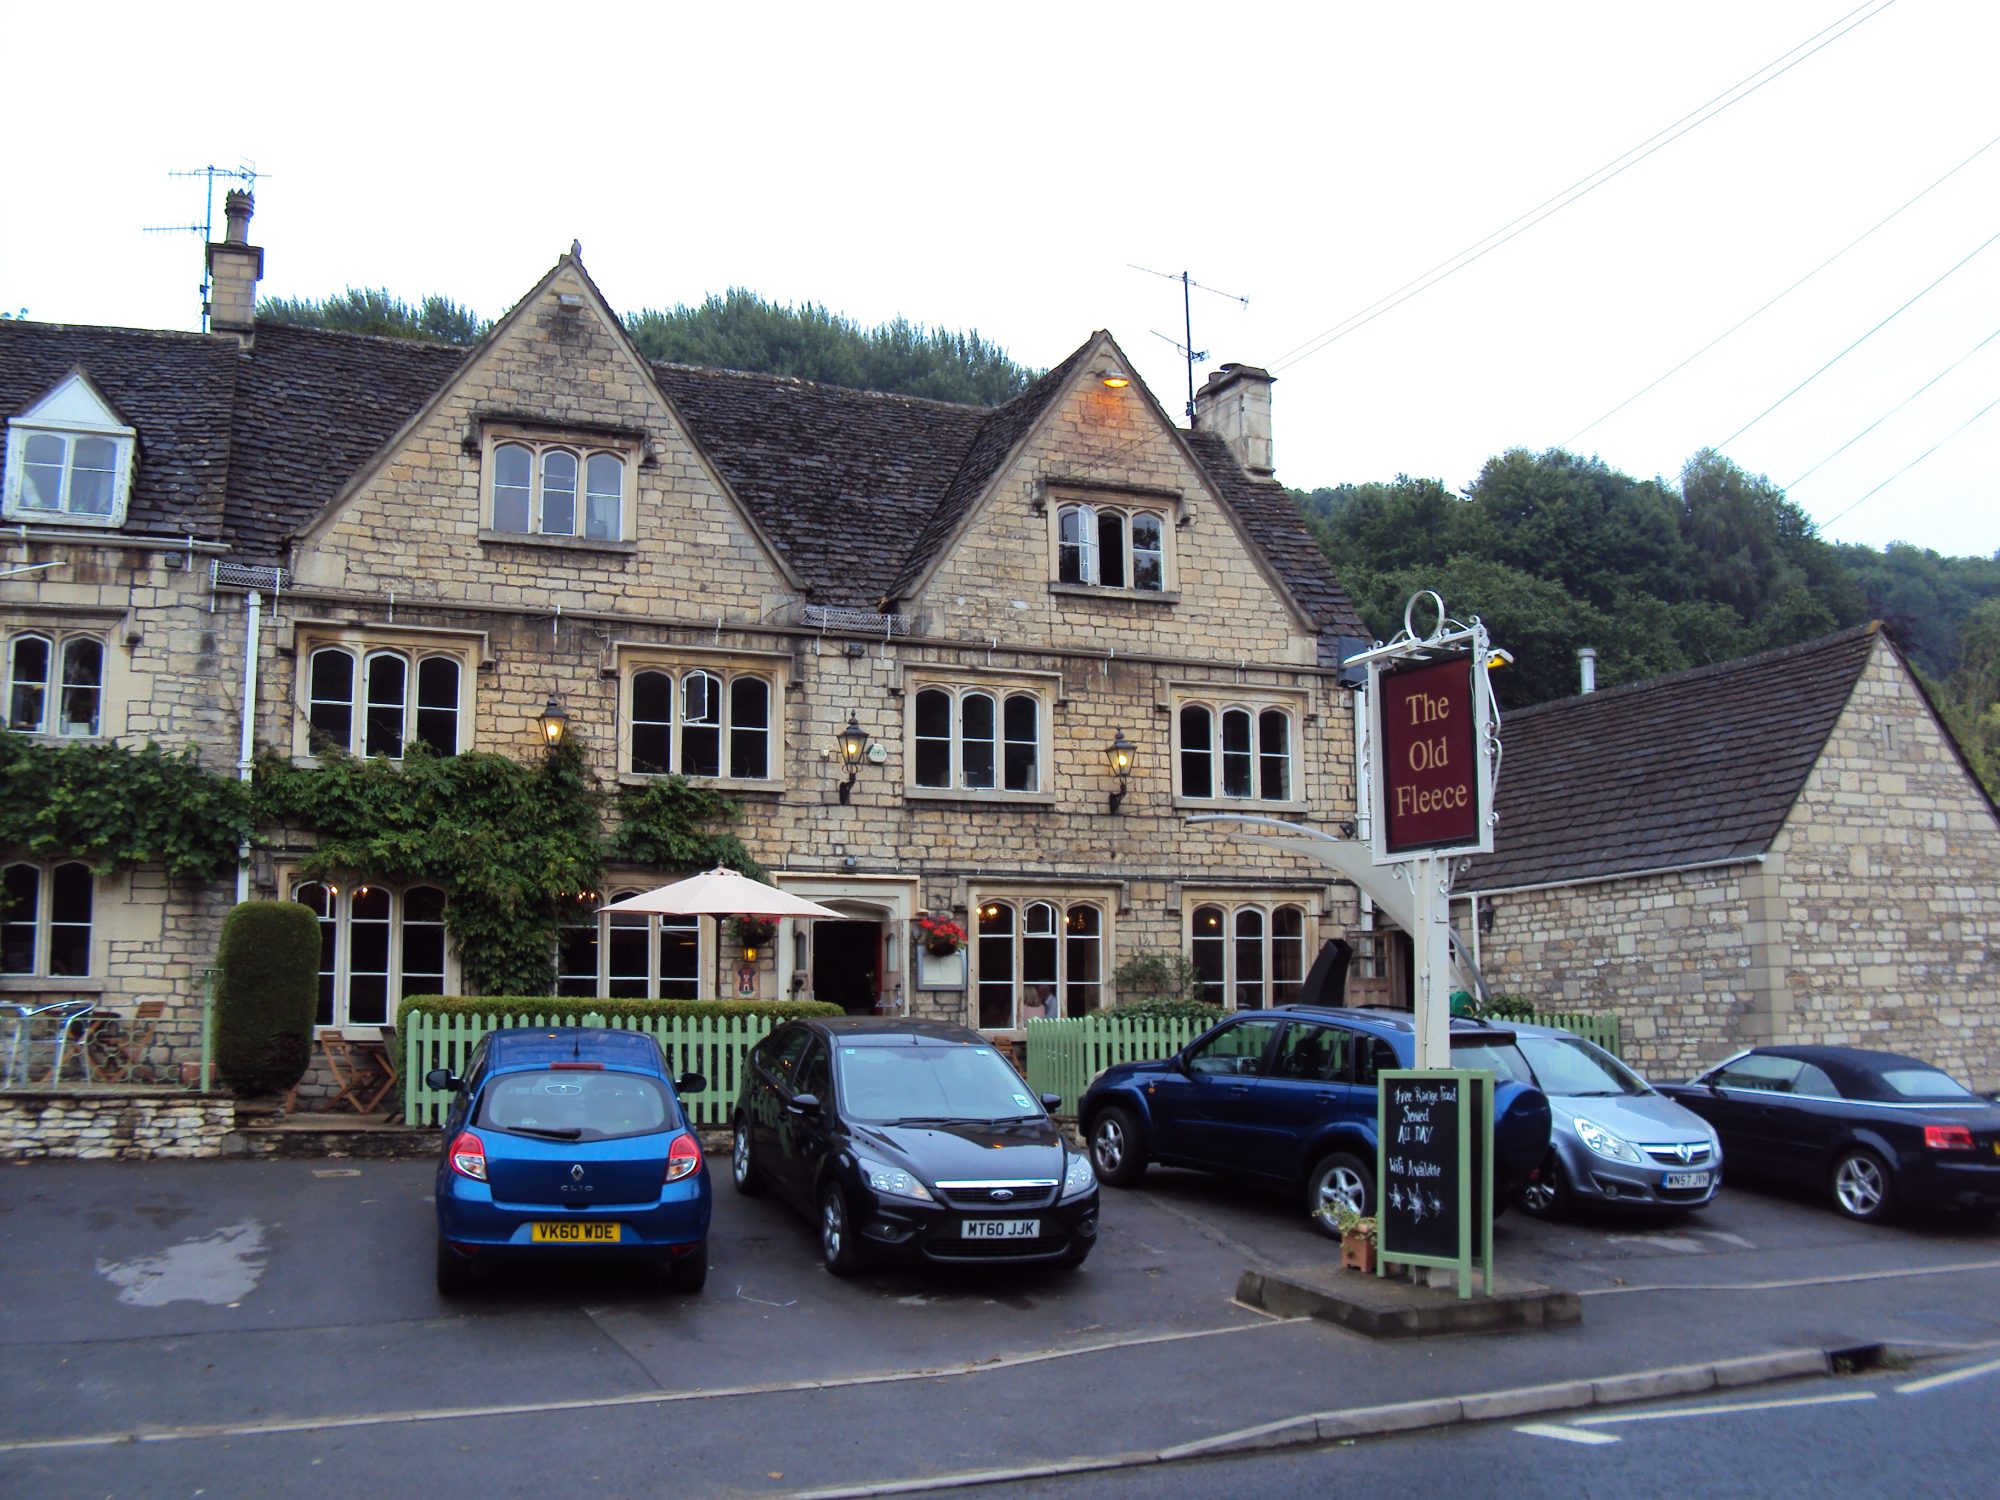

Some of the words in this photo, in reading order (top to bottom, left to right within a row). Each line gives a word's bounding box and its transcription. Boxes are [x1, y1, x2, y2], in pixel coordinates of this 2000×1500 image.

[1405, 692, 1449, 725] The
[1409, 736, 1449, 771] Old
[1396, 784, 1468, 817] Fleece
[1394, 1086, 1412, 1104] Free
[1414, 1086, 1438, 1106] Range
[1440, 1086, 1457, 1102] Food
[1403, 1105, 1429, 1123] Served
[1415, 1125, 1434, 1144] DAY
[1408, 1160, 1441, 1177] Available
[1668, 1175, 1691, 1185] WN57
[540, 1224, 579, 1239] VK60
[584, 1224, 614, 1239] WDE
[968, 1222, 1004, 1236] MT60
[1008, 1222, 1034, 1236] JJK
